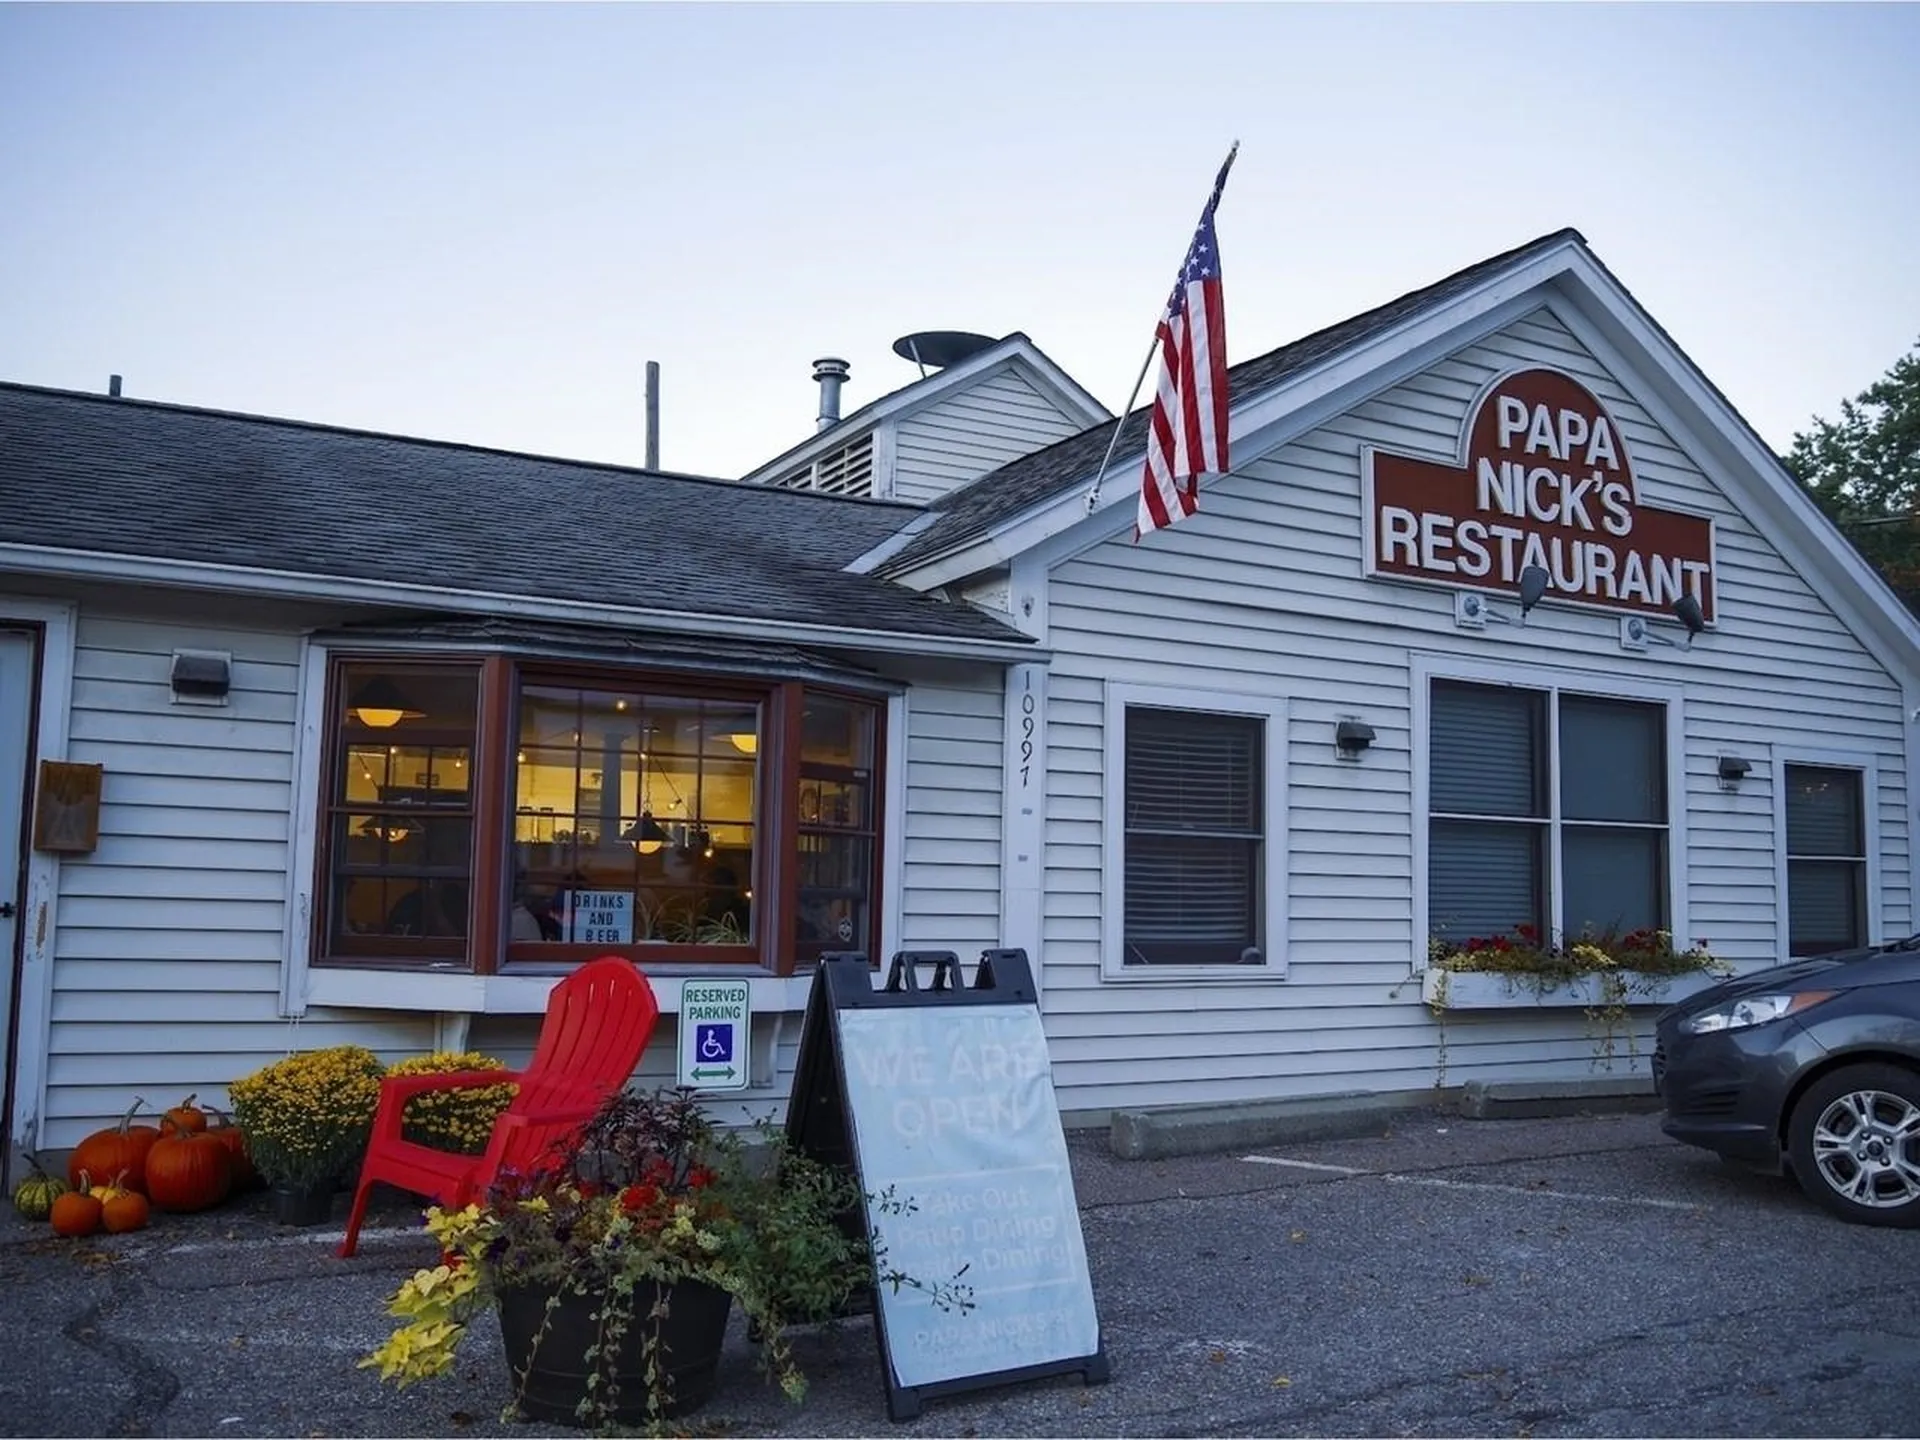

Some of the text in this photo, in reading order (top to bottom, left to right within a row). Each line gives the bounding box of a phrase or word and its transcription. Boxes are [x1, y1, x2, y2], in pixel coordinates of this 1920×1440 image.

[1497, 395, 1621, 470] PAPA
[1477, 457, 1633, 537] NICK'S
[1381, 505, 1710, 612] RESTAURANT
[574, 894, 625, 909] DRINKS
[588, 911, 614, 926] AND
[685, 988, 746, 1003] RESERVED
[689, 1005, 742, 1020] PARKING
[854, 1040, 1040, 1086] WE ARE
[892, 1091, 1021, 1138] OPEN
[982, 1187, 1031, 1210] Out
